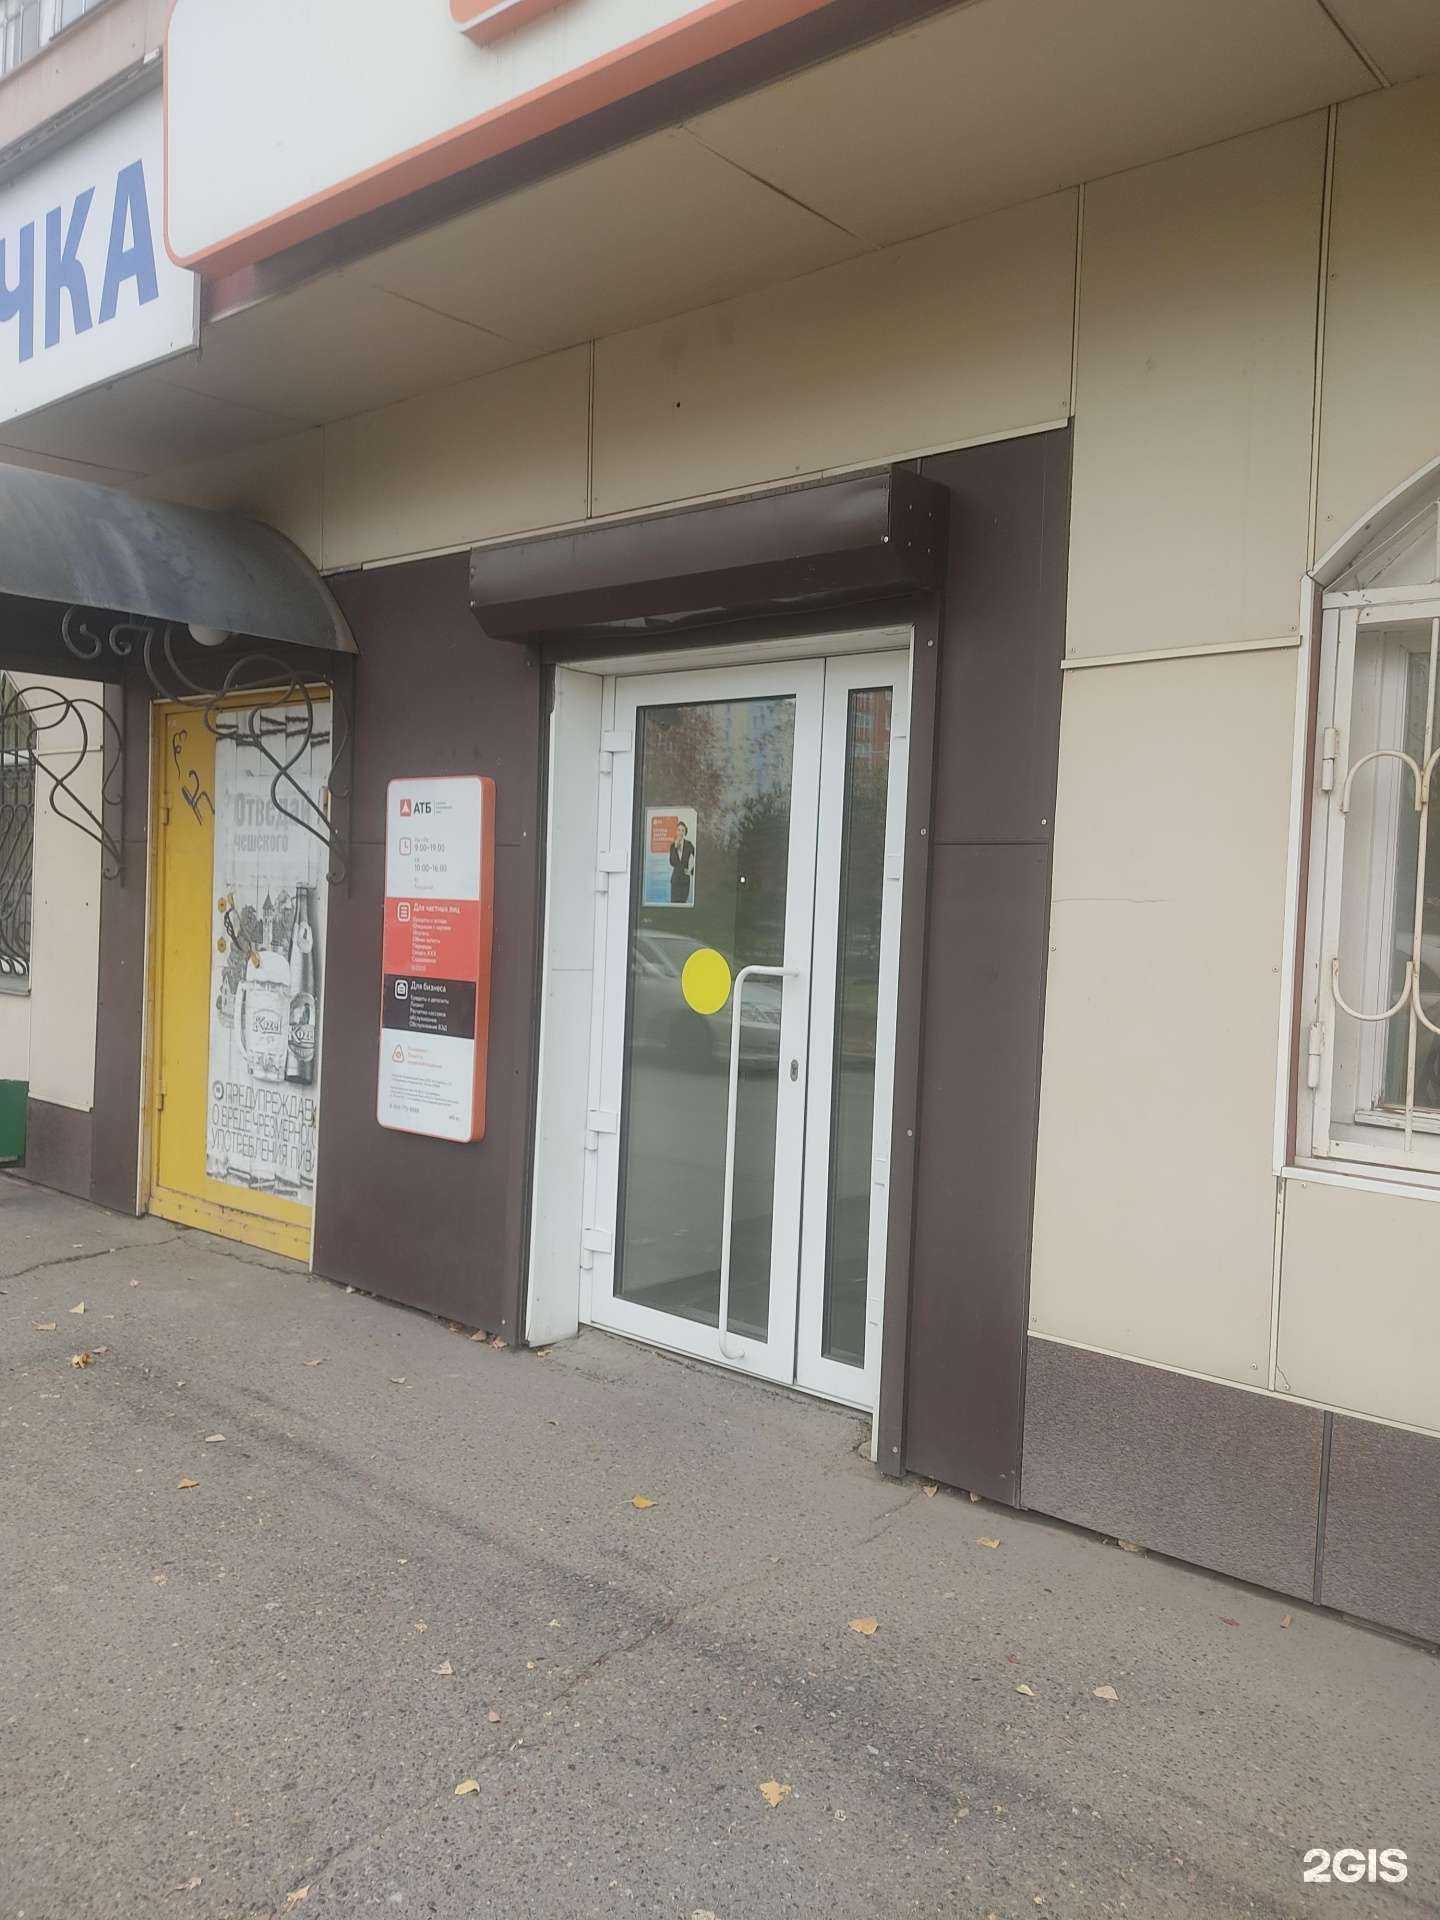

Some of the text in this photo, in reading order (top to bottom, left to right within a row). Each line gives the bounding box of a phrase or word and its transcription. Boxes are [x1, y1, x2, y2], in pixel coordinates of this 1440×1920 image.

[413, 801, 432, 814] АТБ
[410, 980, 447, 993] Для бизнеса
[212, 1103, 220, 1126] О
[222, 1105, 251, 1132] ВРЕДЕ
[211, 1127, 288, 1167] УПОТРЕБЛЕНИЯ
